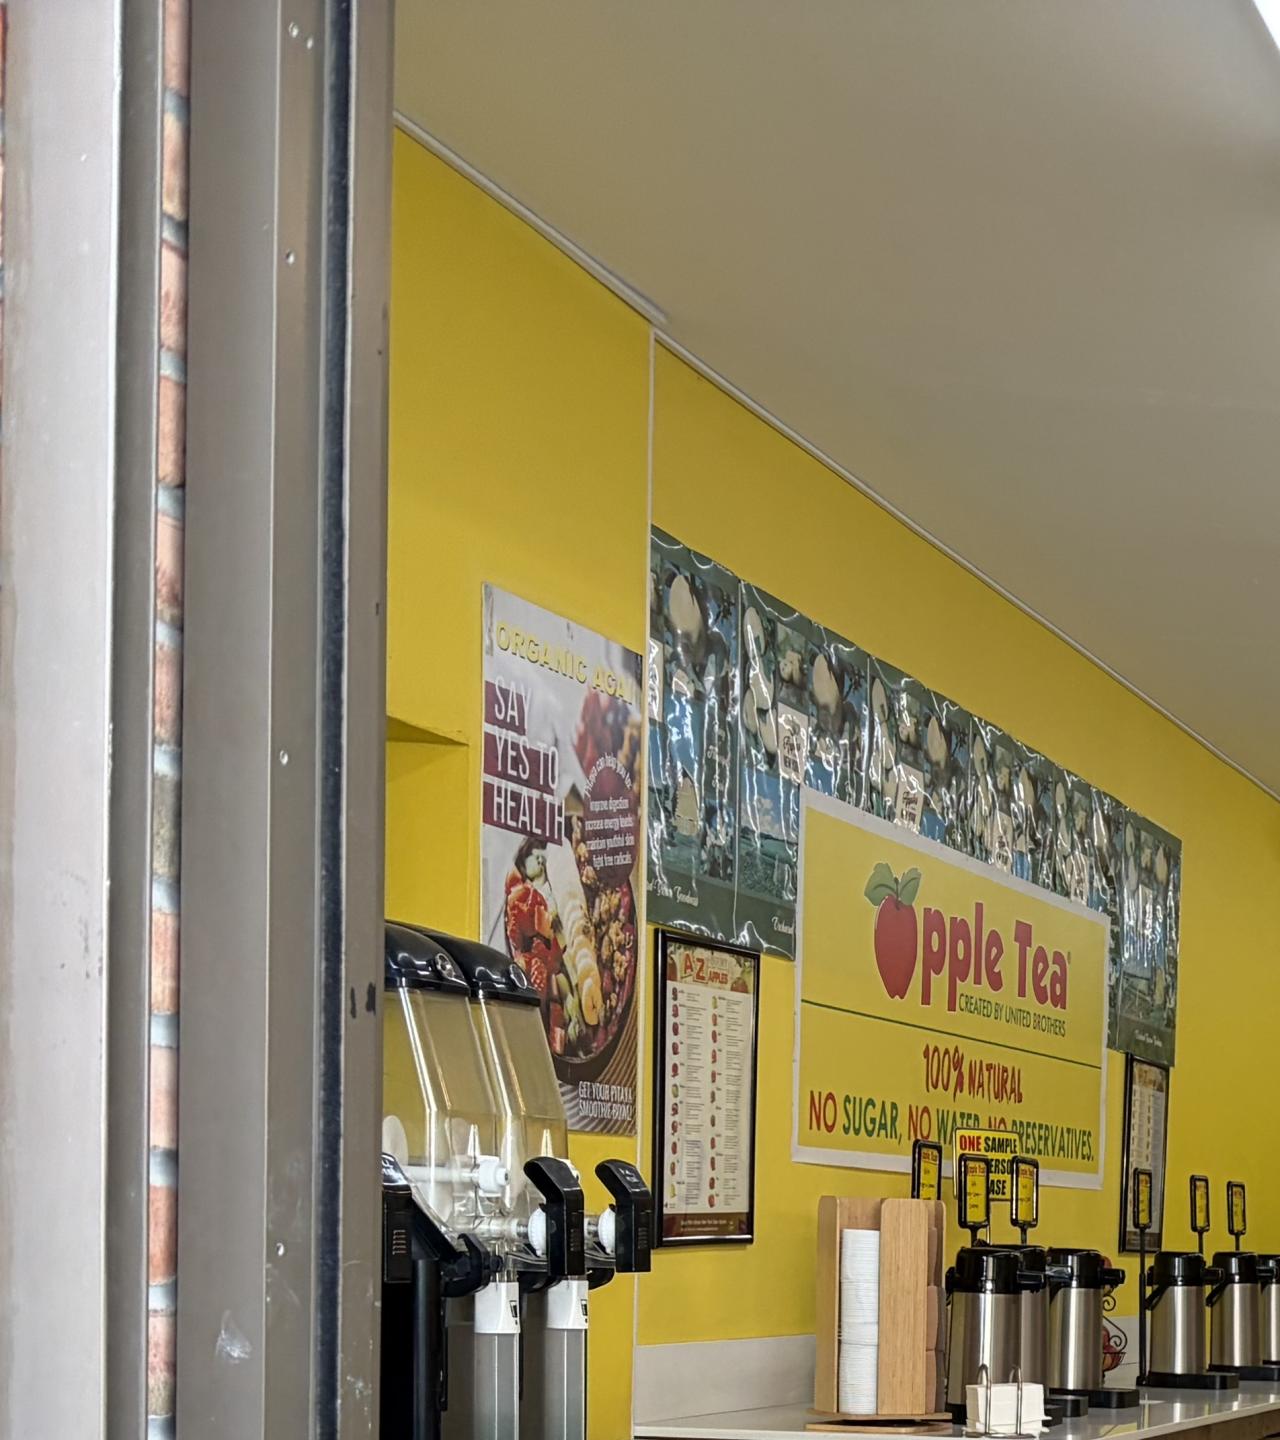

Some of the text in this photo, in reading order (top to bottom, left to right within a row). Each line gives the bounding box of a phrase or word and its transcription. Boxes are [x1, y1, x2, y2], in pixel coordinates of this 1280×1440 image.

[496, 622, 587, 684] ORGANIC
[495, 675, 531, 730] SAY
[495, 730, 559, 789] YES TO
[493, 781, 565, 839] HEALTH
[1013, 919, 1069, 1010] Tea
[958, 993, 1066, 1037] CREATED BY UNITED BROTHERS
[923, 1043, 1024, 1105] 100% NATURAL
[809, 1090, 838, 1134] NO
[842, 1094, 902, 1146] SUGAR,
[908, 1104, 932, 1140] NO
[960, 1134, 1018, 1154] ONE SAMPLE
